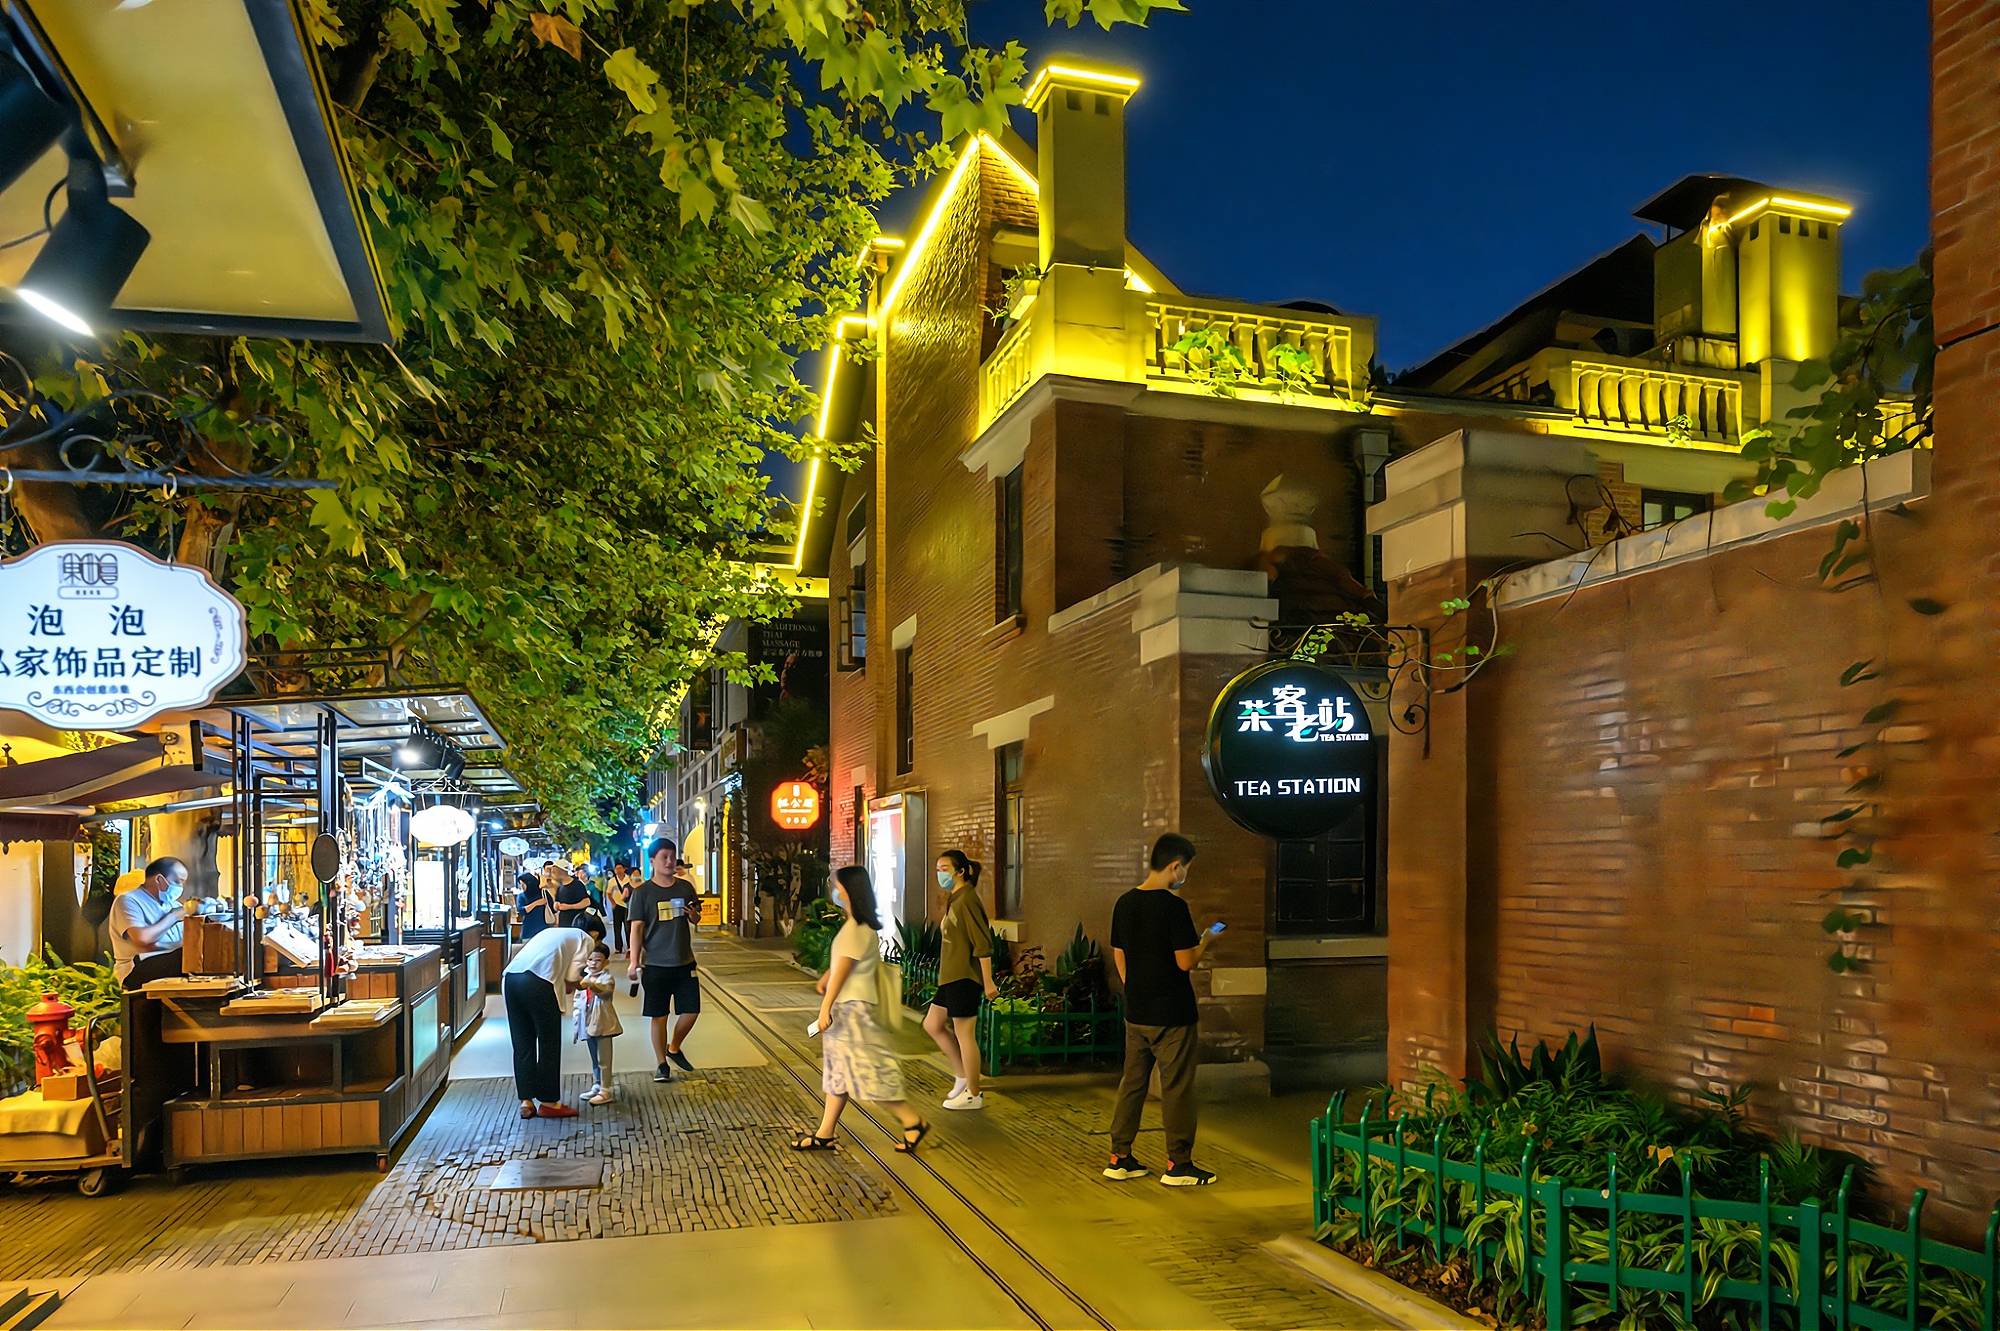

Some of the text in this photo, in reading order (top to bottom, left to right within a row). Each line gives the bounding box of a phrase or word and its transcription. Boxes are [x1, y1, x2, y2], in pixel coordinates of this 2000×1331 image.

[27, 604, 147, 637] 泡泡
[1319, 733, 1369, 742] TEA STATION
[1234, 777, 1361, 797] TEA STATION
